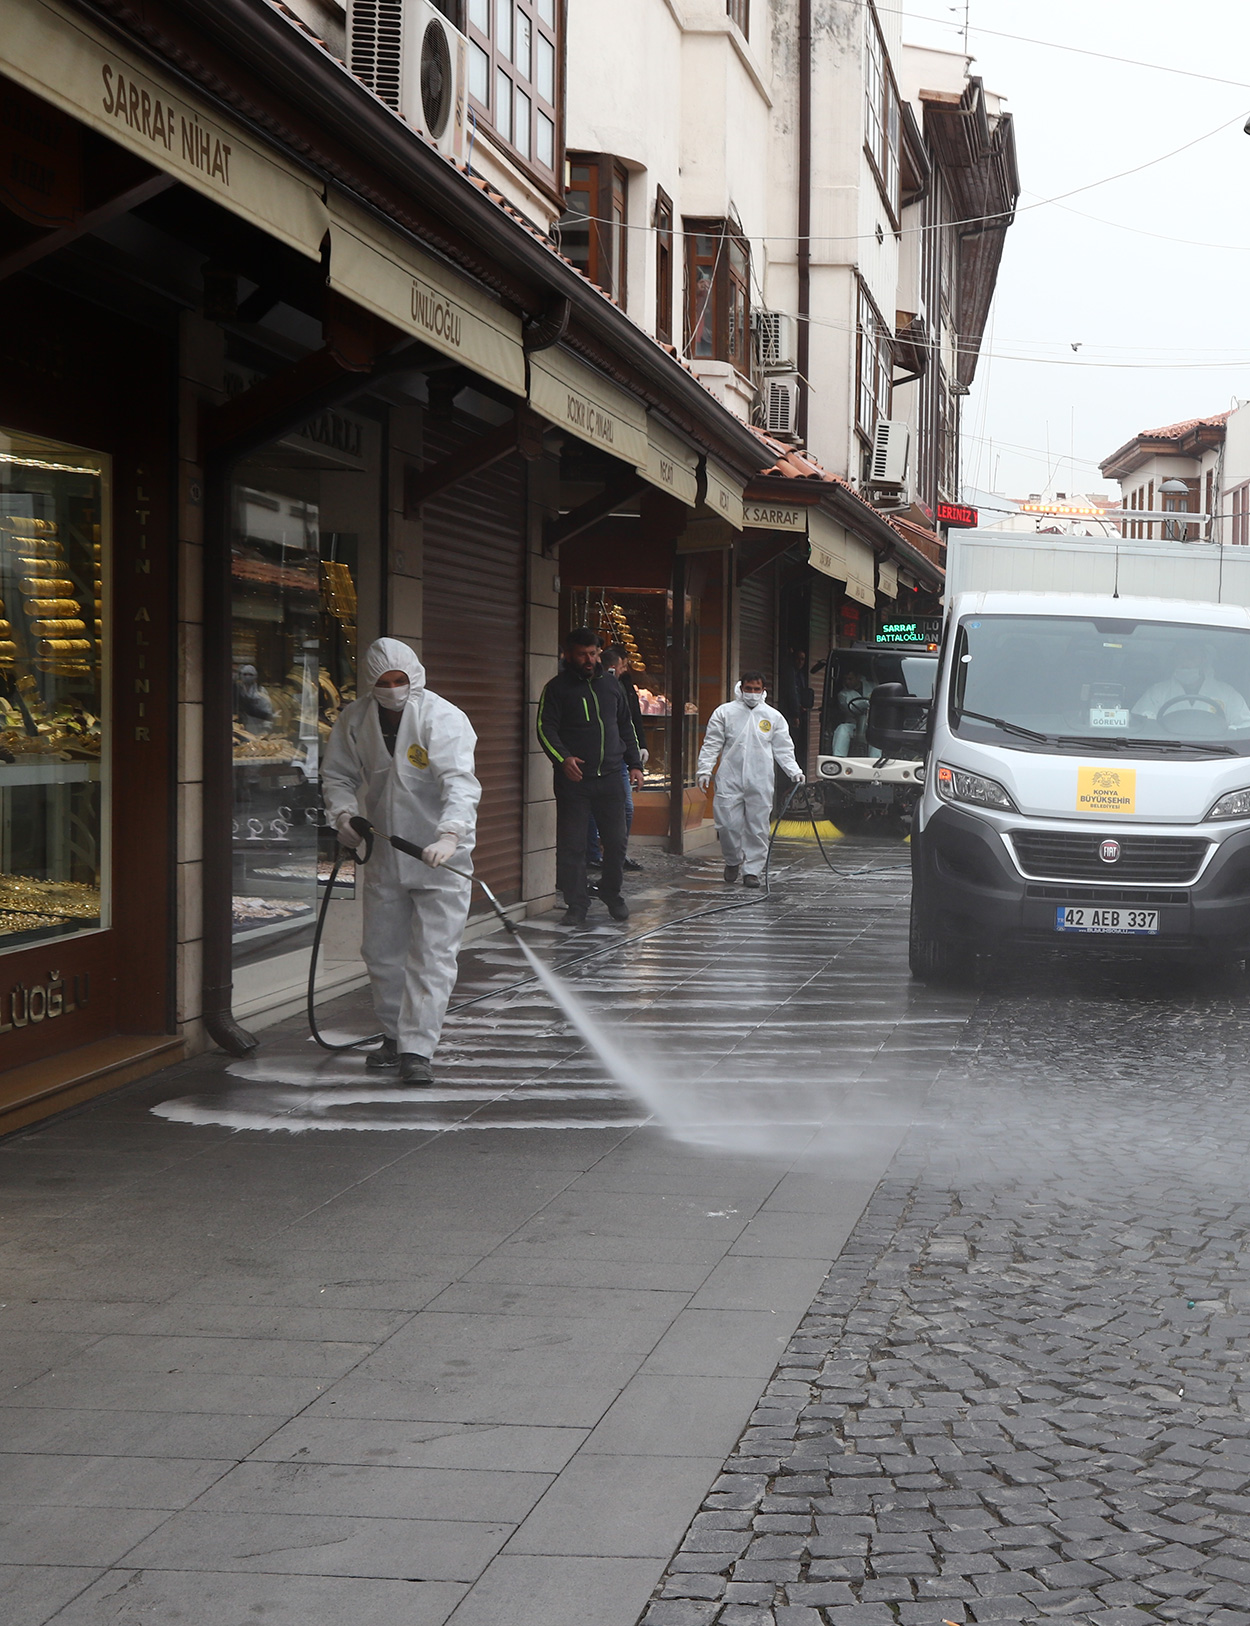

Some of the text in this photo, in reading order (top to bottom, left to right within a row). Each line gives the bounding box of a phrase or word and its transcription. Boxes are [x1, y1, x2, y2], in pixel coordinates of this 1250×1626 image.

[102, 63, 175, 151] SARRAF
[181, 114, 231, 187] NİHAT
[411, 279, 461, 347] ÜNLÜOĞLU
[136, 468, 151, 575] LTIN
[753, 508, 799, 525] SARRAF
[882, 623, 917, 633] SARRAF
[876, 631, 924, 643] BATTALOĞLU
[1093, 718, 1126, 726] GÖREVLİ
[1080, 794, 1131, 805] BÜYÜKŞEHİR
[1103, 846, 1117, 857] FIAT
[1066, 909, 1156, 928] 42 AEB 337
